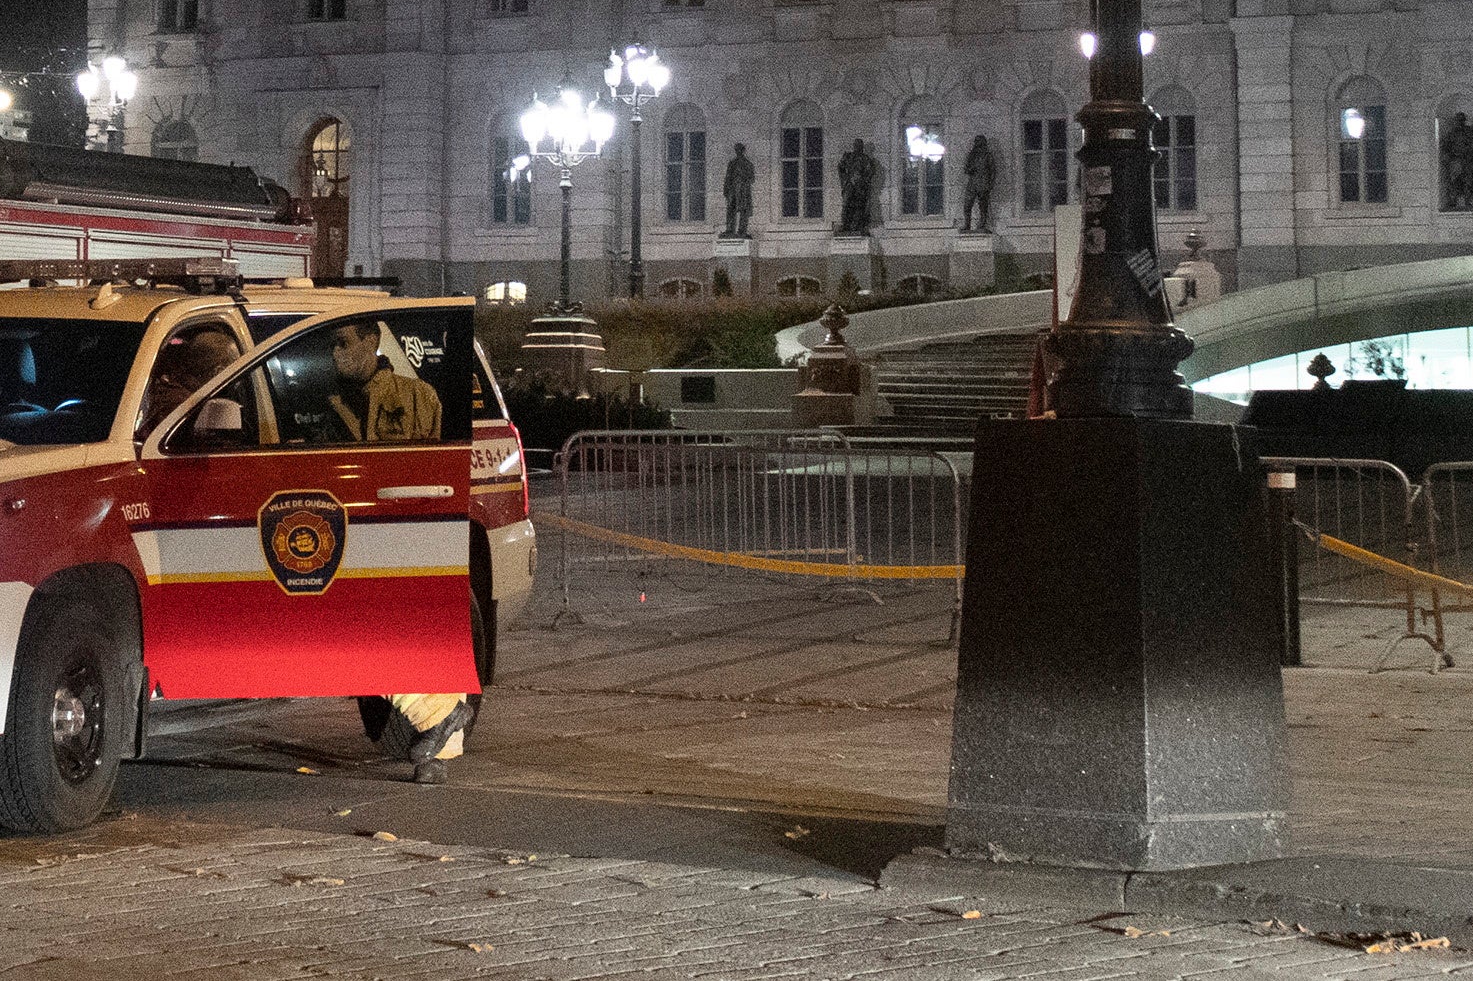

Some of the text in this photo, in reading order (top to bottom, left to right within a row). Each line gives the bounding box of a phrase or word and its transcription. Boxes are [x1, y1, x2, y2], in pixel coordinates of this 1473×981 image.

[121, 502, 150, 521] 16276
[268, 501, 291, 512] VILLE
[292, 500, 303, 508] DE
[287, 578, 324, 586] INCENDIE
